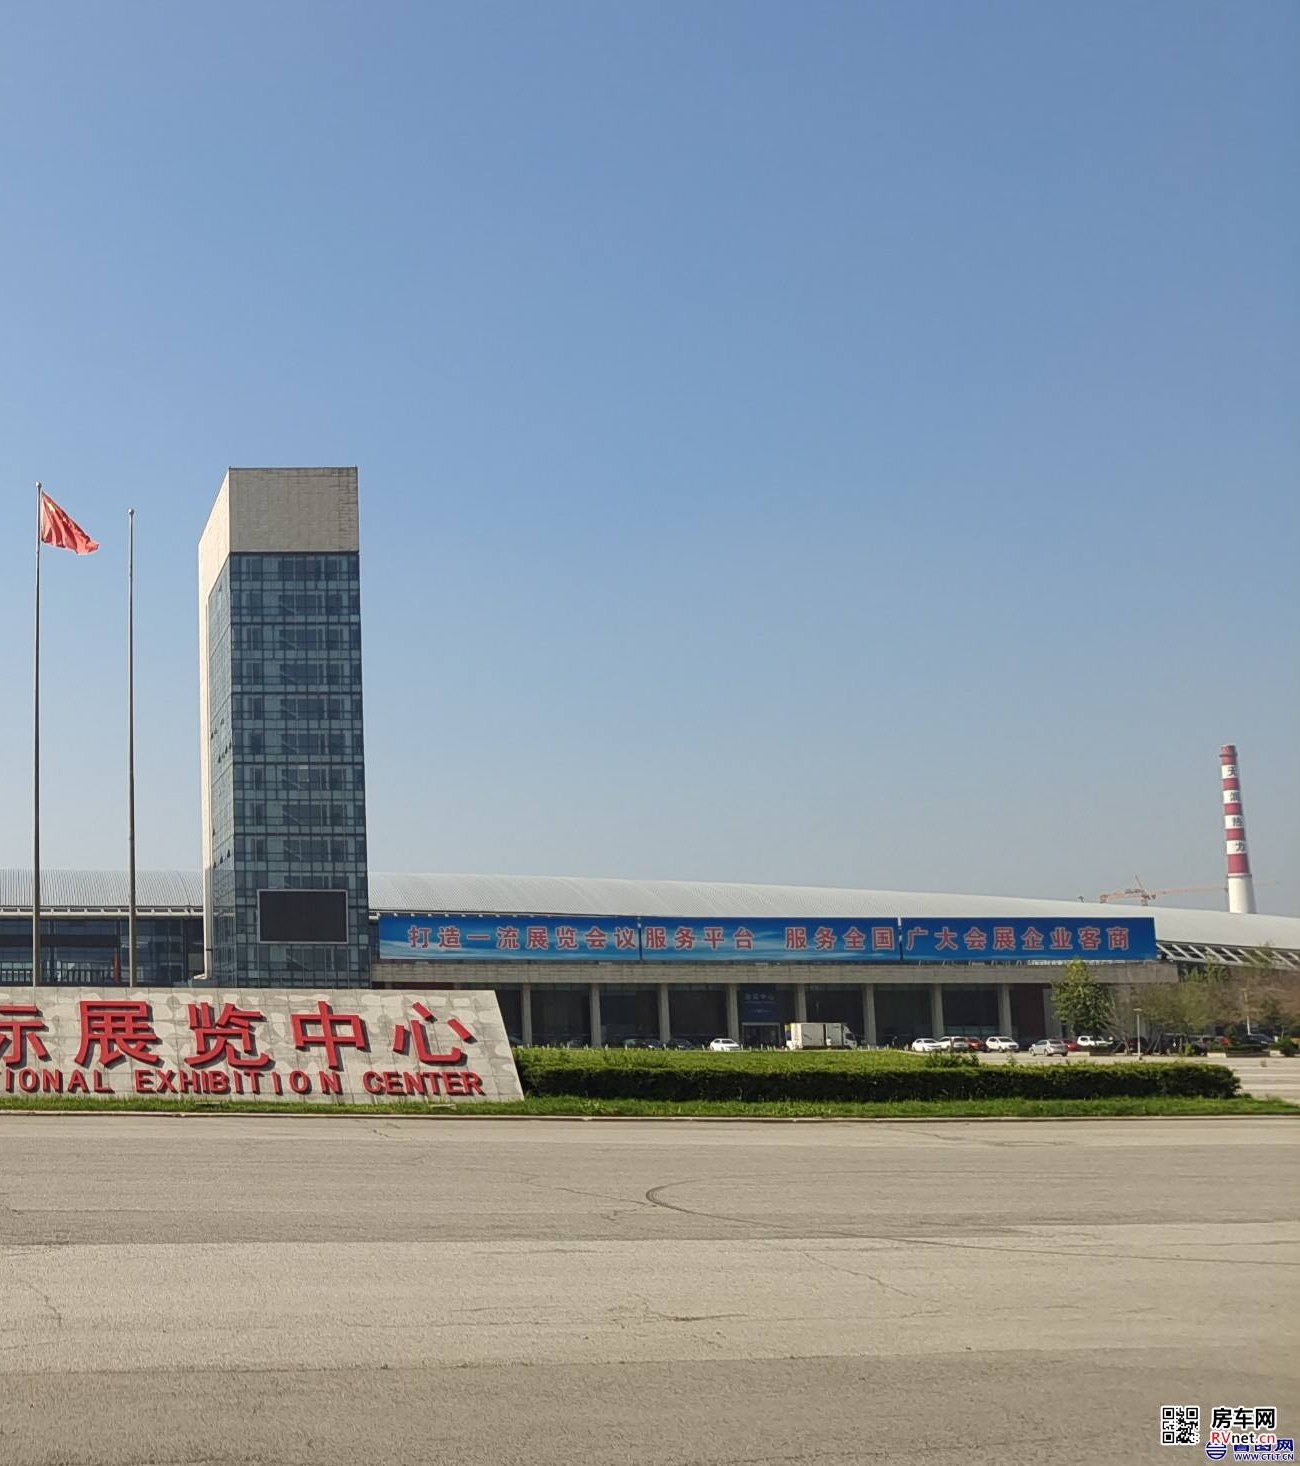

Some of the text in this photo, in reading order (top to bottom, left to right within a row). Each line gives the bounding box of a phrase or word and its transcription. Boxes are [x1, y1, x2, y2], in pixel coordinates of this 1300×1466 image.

[408, 925, 1130, 951] 打造一流展览会议服务平台 服务全国广大会展企业客商
[134, 1068, 341, 1094] EXHIBITION
[362, 1069, 485, 1095] CENTER
